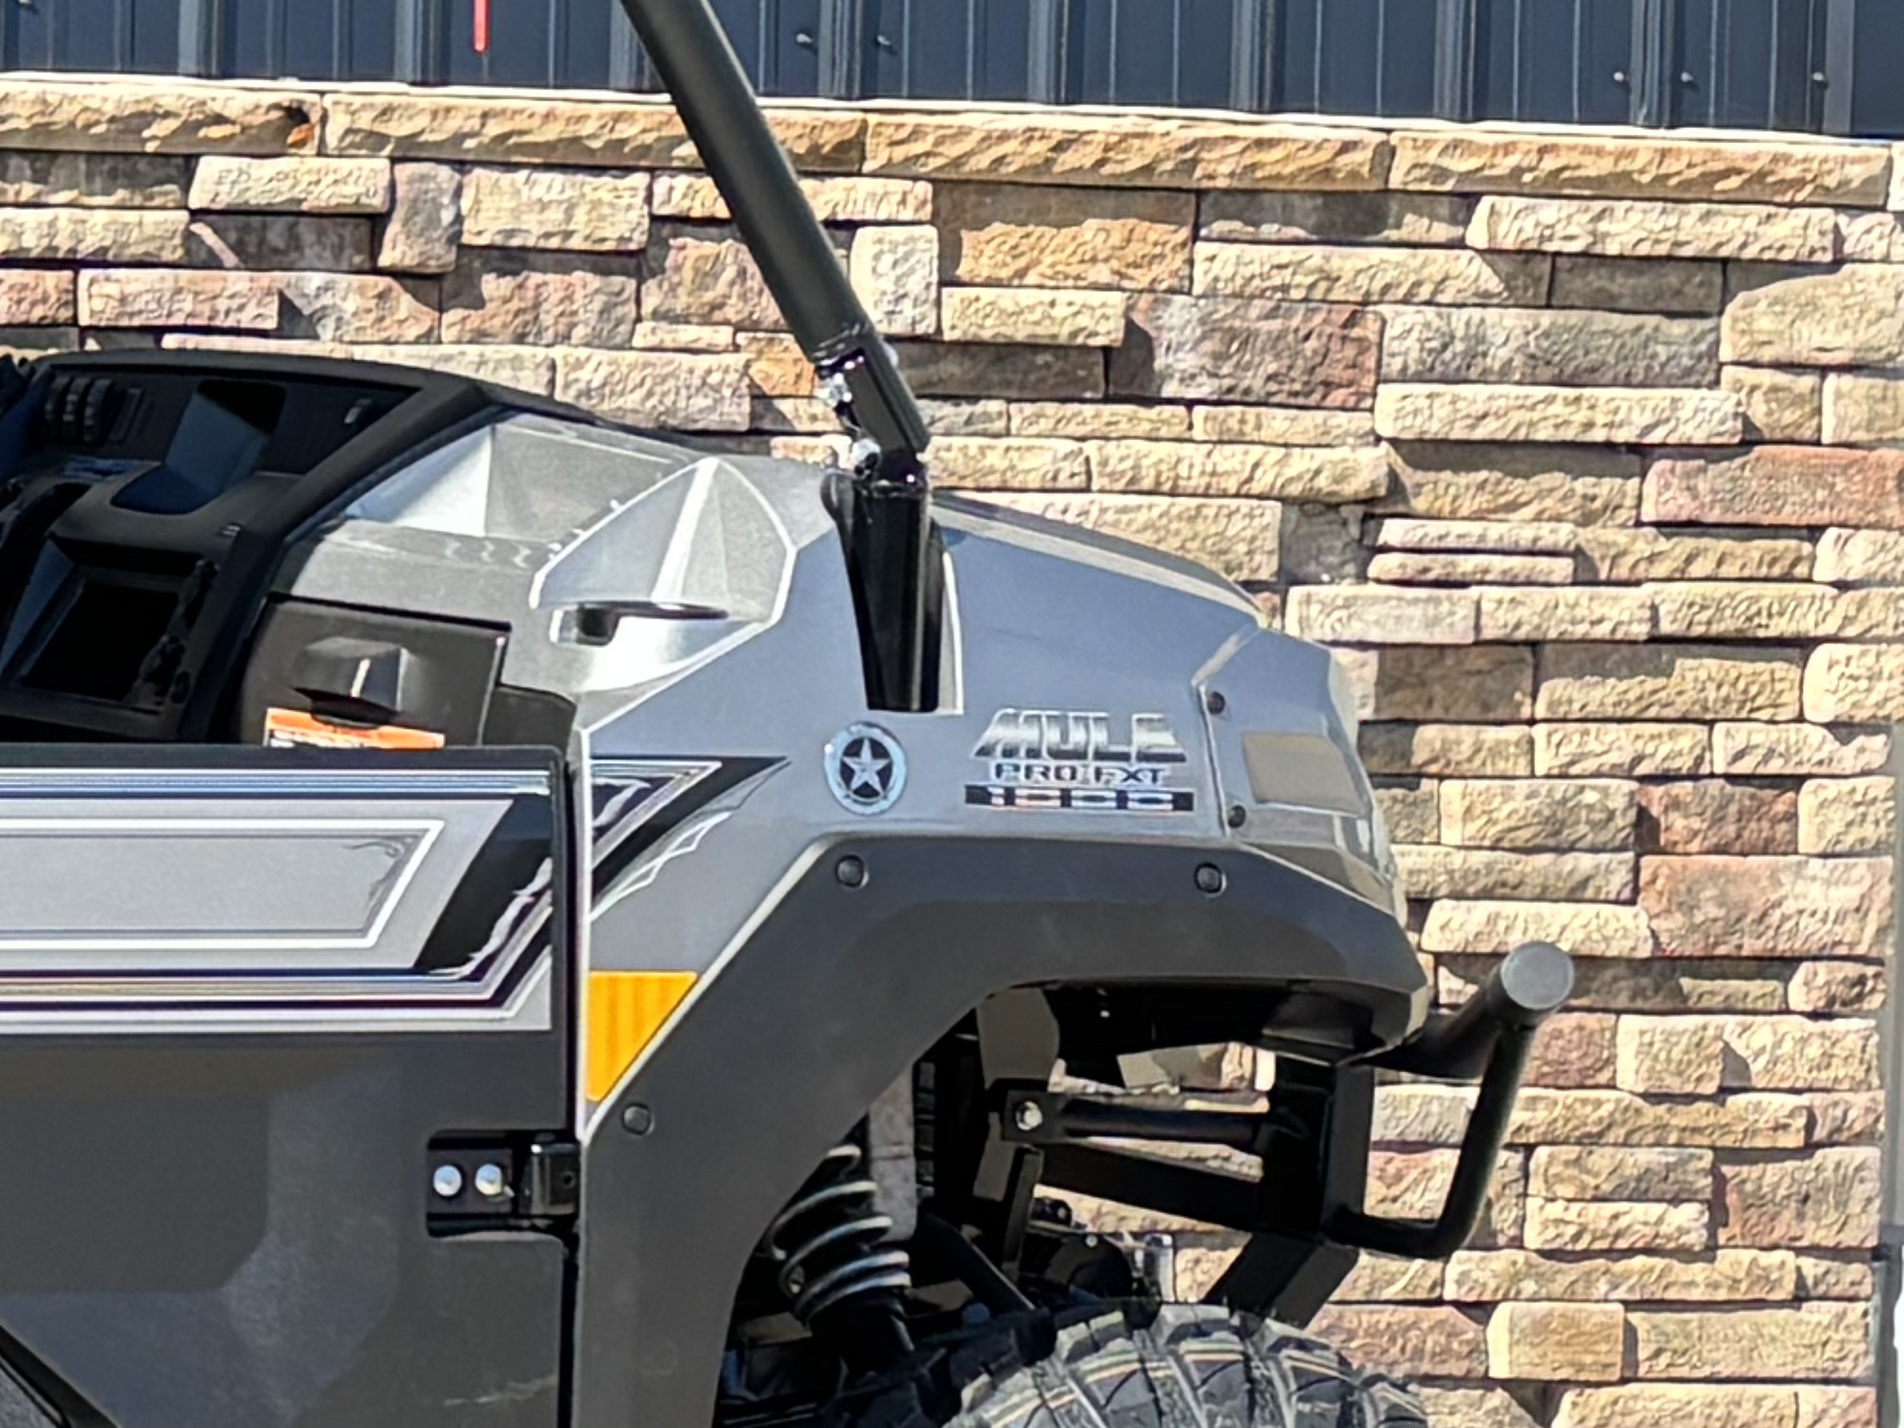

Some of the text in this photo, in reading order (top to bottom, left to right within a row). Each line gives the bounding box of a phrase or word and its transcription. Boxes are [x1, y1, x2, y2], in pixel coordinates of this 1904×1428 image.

[971, 708, 1187, 763] MULE
[993, 761, 1167, 785] PRO FXT
[987, 786, 1174, 811] 1000
